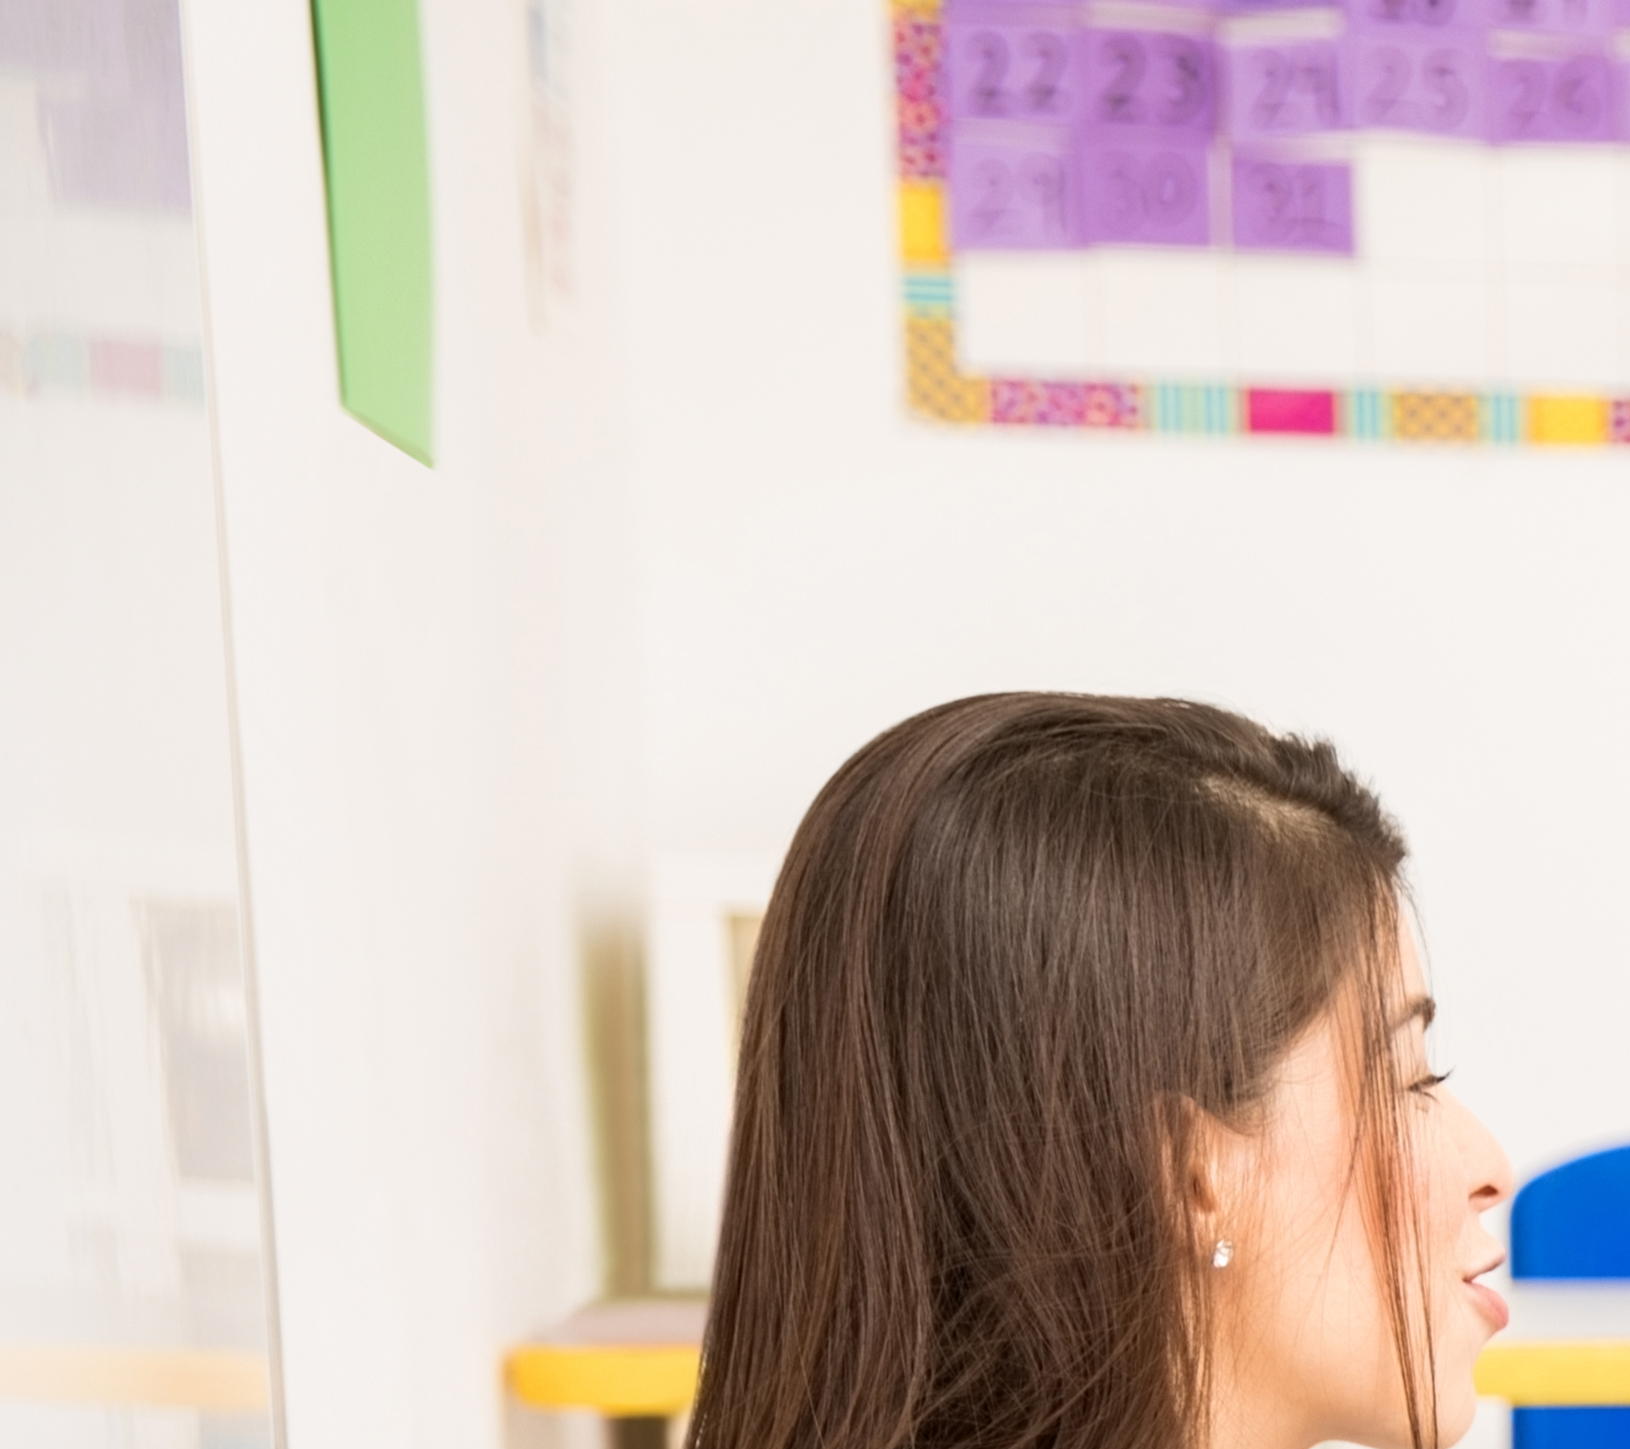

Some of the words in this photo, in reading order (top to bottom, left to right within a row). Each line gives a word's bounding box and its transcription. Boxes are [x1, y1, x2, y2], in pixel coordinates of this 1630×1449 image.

[966, 30, 1068, 118] 22
[1101, 31, 1206, 126] 23
[1361, 46, 1469, 131] 25
[1096, 150, 1199, 235] 30
